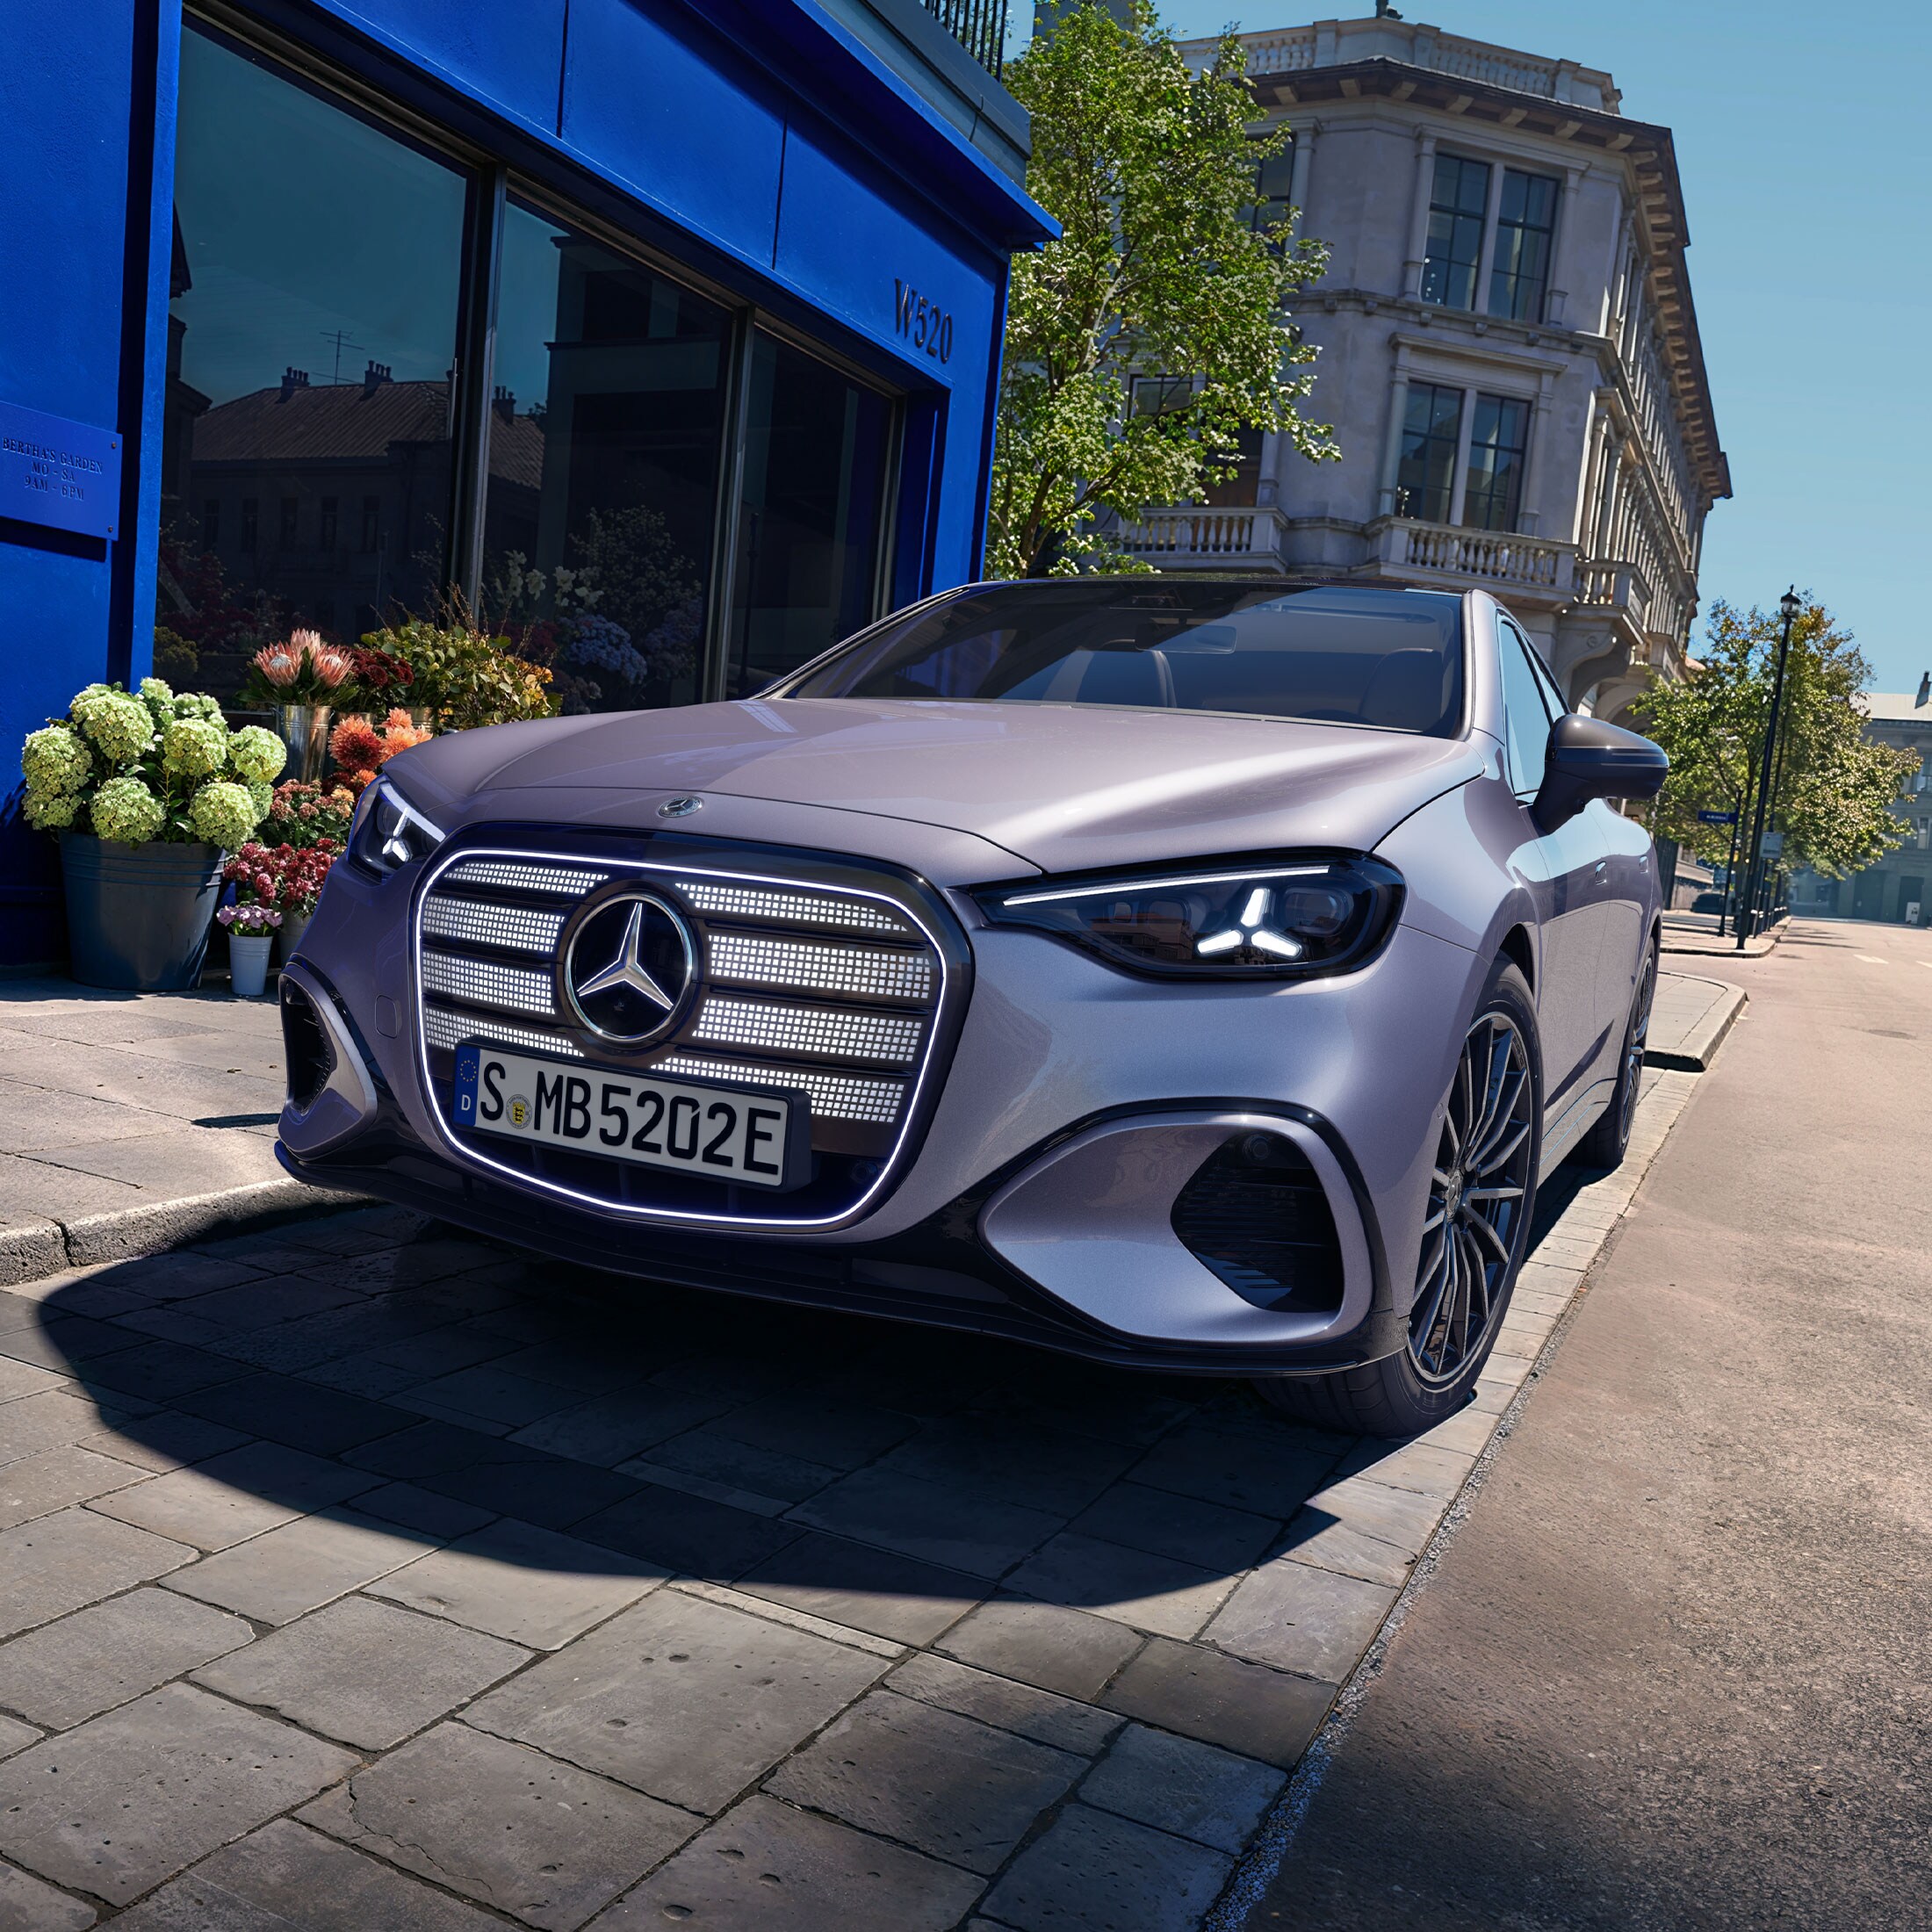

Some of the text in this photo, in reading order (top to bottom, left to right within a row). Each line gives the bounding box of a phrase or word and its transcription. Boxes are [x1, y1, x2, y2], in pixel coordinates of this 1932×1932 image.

[895, 278, 953, 364] W520
[3, 437, 103, 474] BERTHA'S GARDEN
[25, 475, 48, 493] 9AM
[61, 486, 84, 501] 6PM
[32, 462, 49, 477] MO
[61, 469, 76, 483] SA
[461, 1094, 472, 1111] D
[480, 1062, 506, 1121] S
